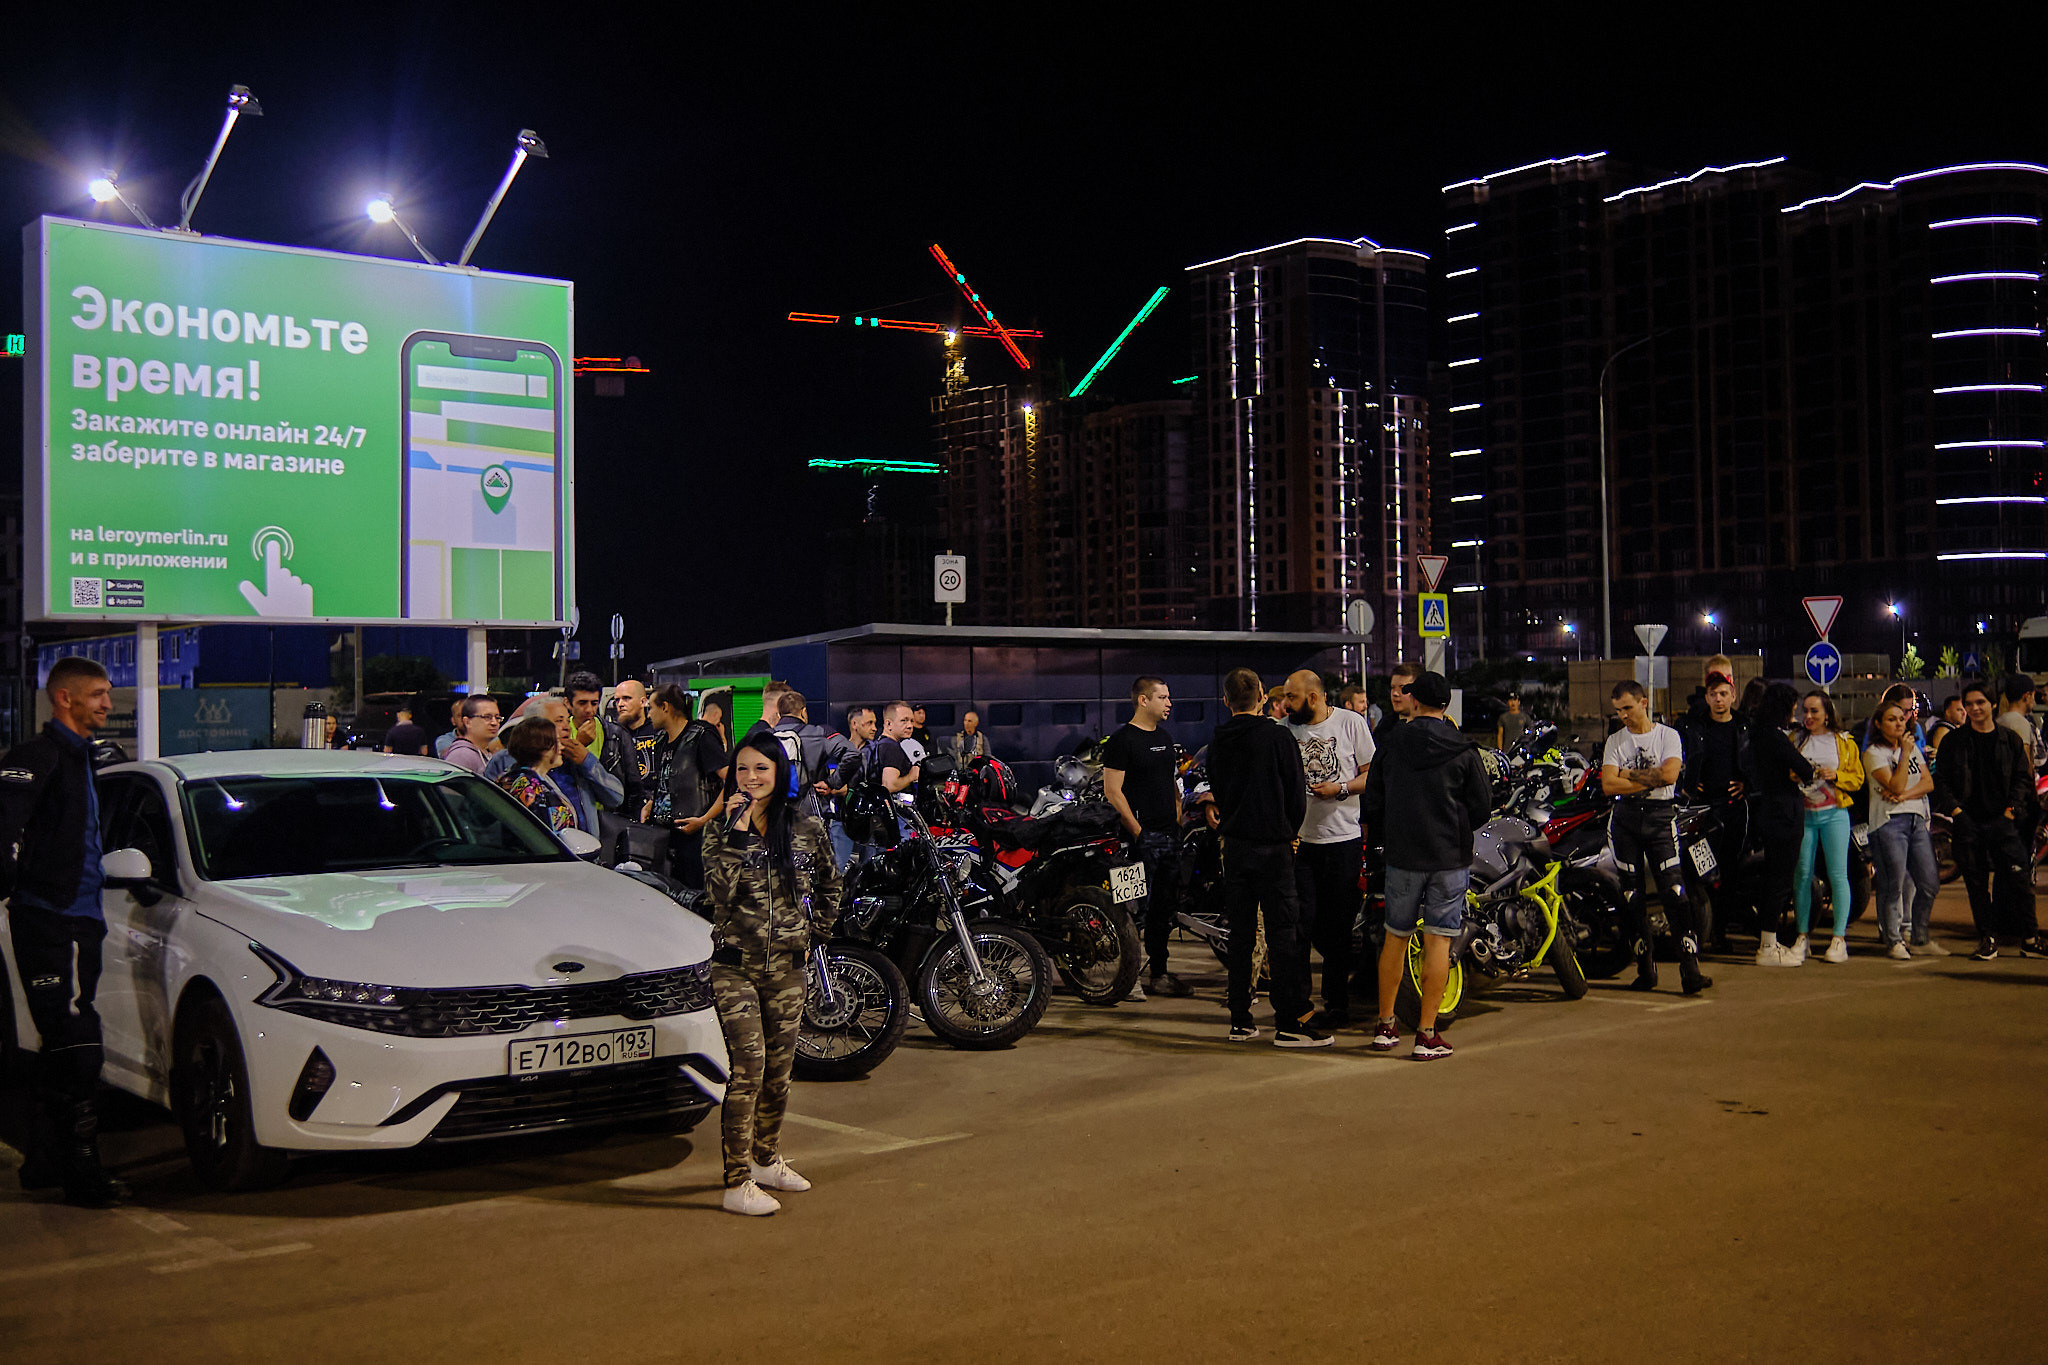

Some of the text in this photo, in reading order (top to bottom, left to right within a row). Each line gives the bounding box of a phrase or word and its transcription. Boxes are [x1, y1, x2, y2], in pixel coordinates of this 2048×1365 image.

[71, 285, 369, 355] Экономьте
[72, 353, 261, 402] время!
[71, 408, 367, 449] Закажите онлайн 24/7
[71, 440, 345, 475] заберите в магазине
[71, 525, 228, 547] на leroymerlin.ru
[71, 552, 227, 570] и в приложении
[944, 575, 957, 585] 20
[1117, 866, 1141, 882] 1621
[1133, 883, 1145, 897] 23
[615, 1031, 647, 1053] 193
[622, 1051, 638, 1059] RUS
